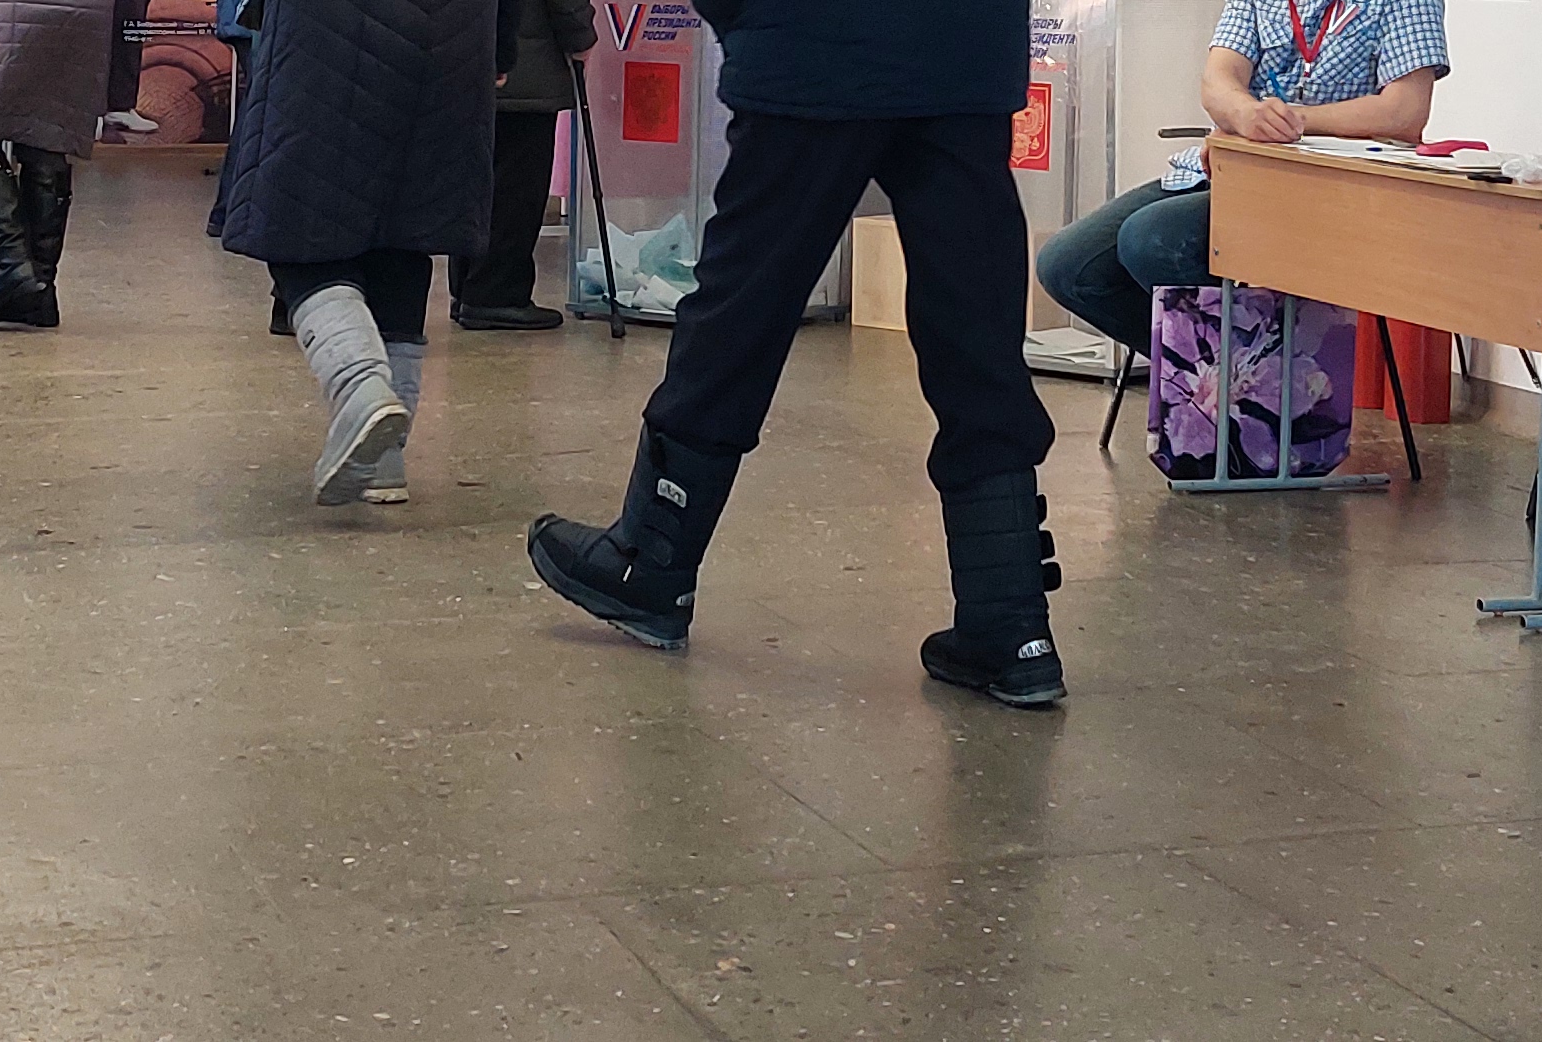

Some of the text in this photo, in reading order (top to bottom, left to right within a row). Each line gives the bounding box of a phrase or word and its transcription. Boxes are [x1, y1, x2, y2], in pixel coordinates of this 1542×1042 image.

[651, 4, 689, 14] ВЫБОРЫ
[646, 18, 701, 28] ПРЕЗИДЕНТА
[642, 30, 677, 40] РОССИИ
